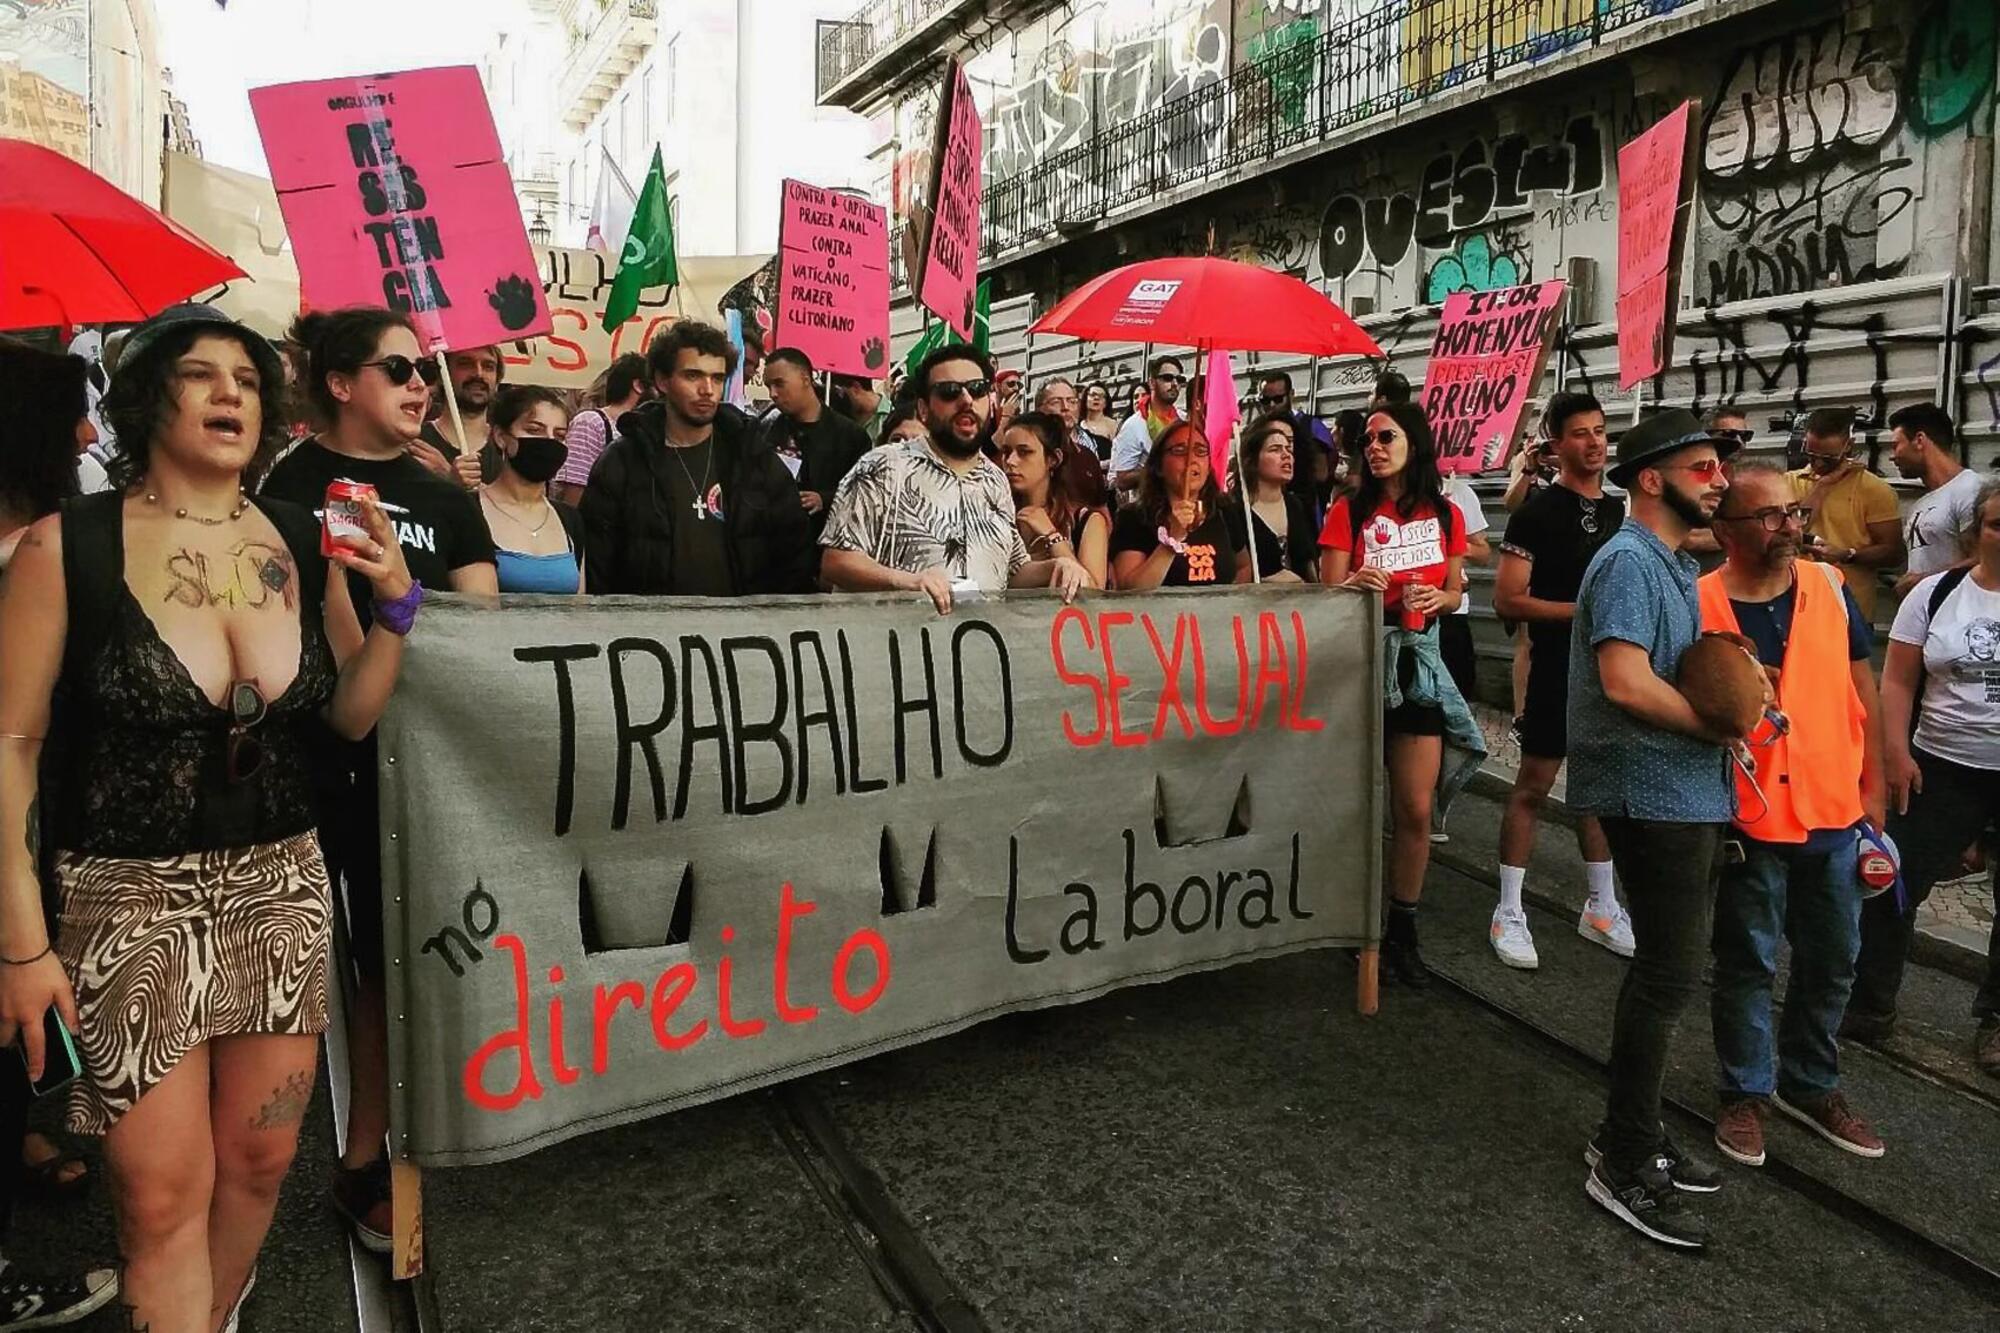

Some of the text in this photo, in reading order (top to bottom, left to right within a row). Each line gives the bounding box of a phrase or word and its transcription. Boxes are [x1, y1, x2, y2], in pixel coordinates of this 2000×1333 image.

[789, 183, 826, 204] CONTRA
[799, 207, 869, 236] PRAZER ANAL
[811, 235, 852, 257] CONTRA
[933, 225, 964, 282] REGRAS
[827, 257, 836, 269] O
[791, 285, 833, 307] PRAZER
[1140, 283, 1180, 293] GAT
[788, 307, 855, 332] CLITORIANO
[1425, 374, 1517, 422] BRUNO
[514, 606, 1327, 836] TRABALHO SEXUAL
[464, 880, 892, 1112] direito
